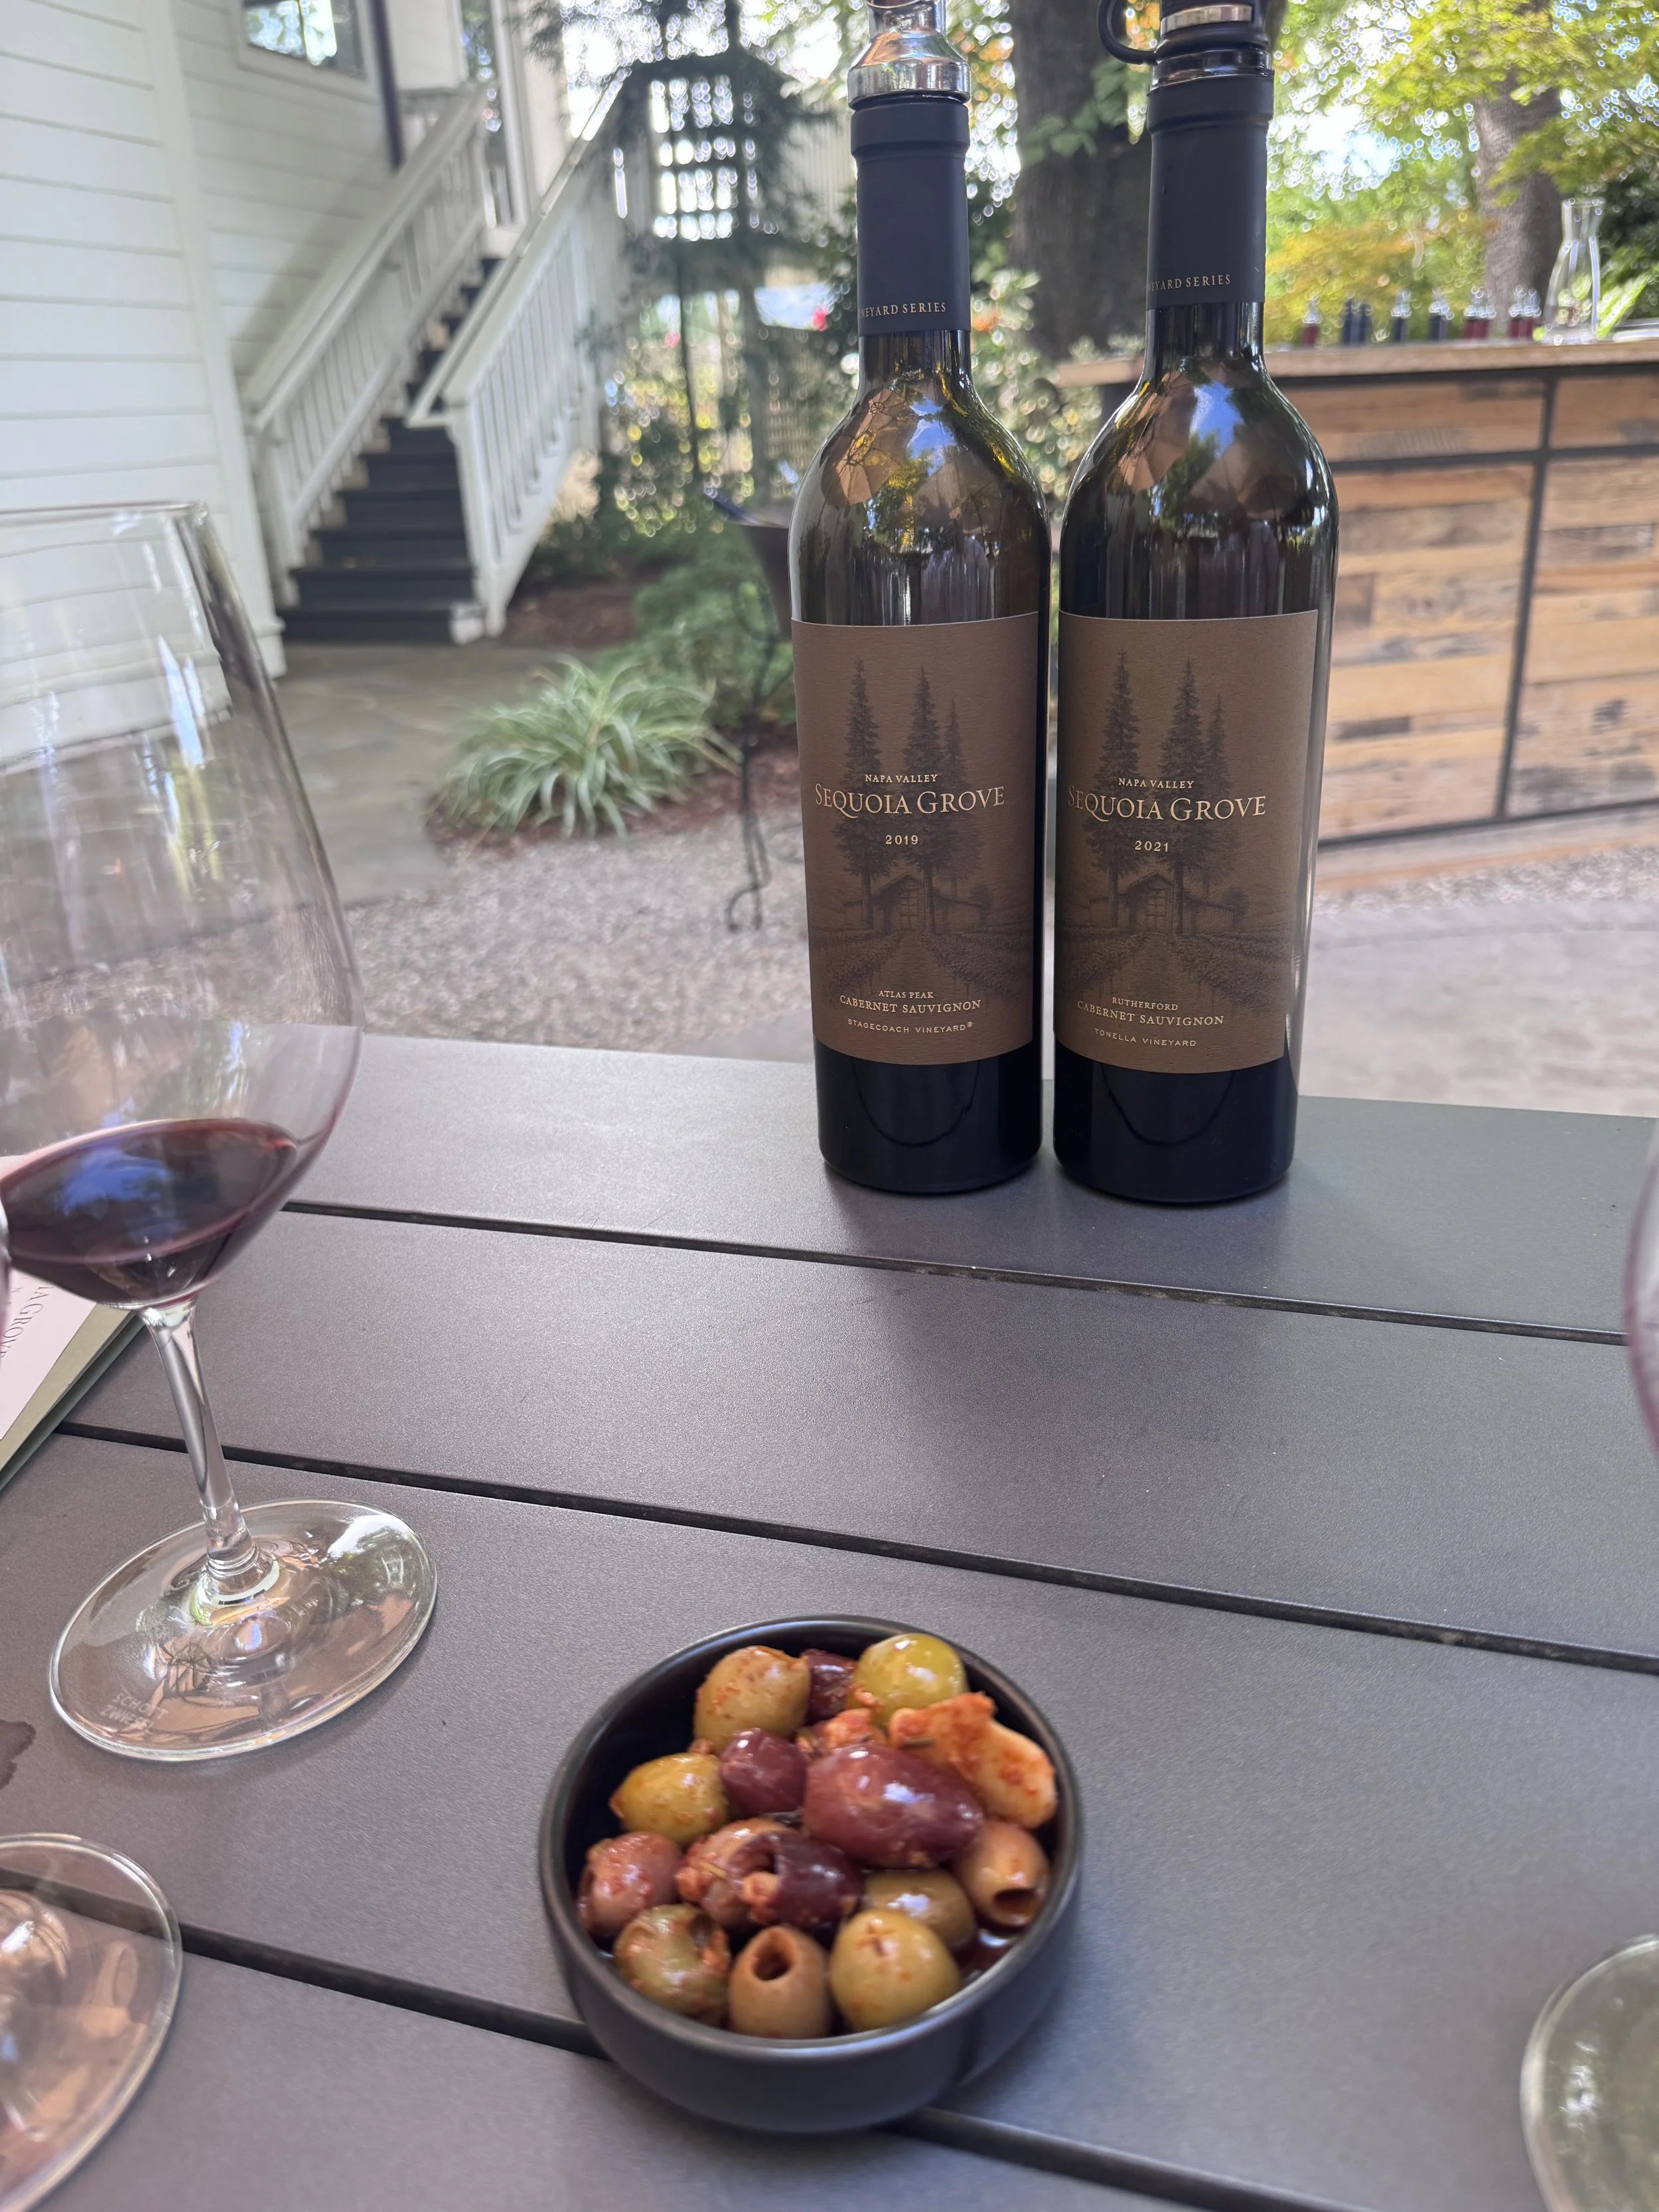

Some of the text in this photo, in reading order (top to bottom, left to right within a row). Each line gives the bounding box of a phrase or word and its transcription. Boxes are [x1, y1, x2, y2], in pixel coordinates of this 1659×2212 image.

[1186, 274, 1231, 287] SERIES
[902, 302, 946, 314] SERIES
[865, 774, 938, 783] NAPA VALLEY
[1118, 777, 1195, 789] NAPA VALLEY
[815, 783, 1005, 818] SEQUOIA GROVE
[1067, 784, 1267, 822] SEQUOIA GROVE
[885, 834, 919, 846] 2019
[1134, 840, 1169, 853] 2021
[878, 990, 934, 999] ATLAS PEAK
[839, 995, 981, 1014] CABERNET SAUVIGNON
[1112, 997, 1179, 1011] RUTHERFORD
[1077, 1000, 1224, 1027] CABERNET SAUVIGNON
[847, 1018, 910, 1033] STAGECOACH
[1094, 1028, 1197, 1047] TONELLA VINEYARD
